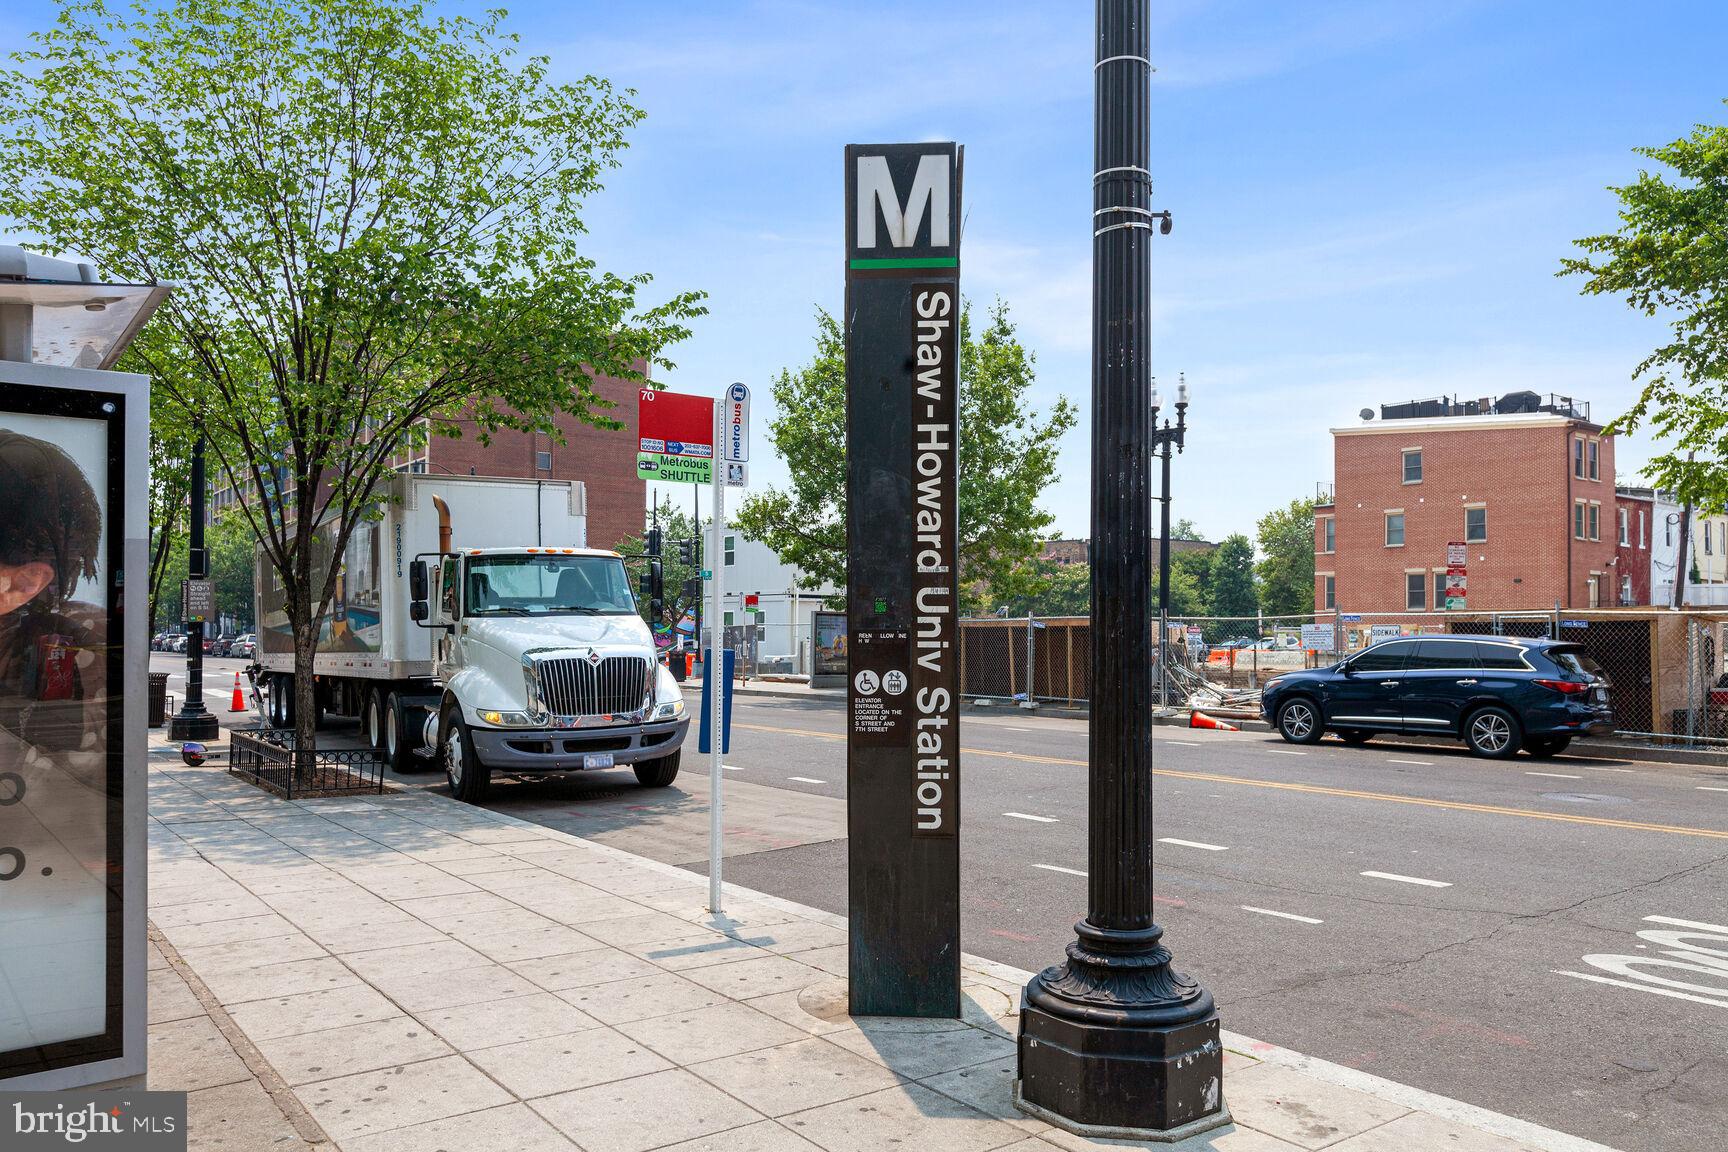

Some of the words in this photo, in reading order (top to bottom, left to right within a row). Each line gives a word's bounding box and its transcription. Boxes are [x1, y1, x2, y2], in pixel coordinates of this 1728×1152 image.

[857, 154, 950, 248] M
[640, 390, 654, 402] 70
[732, 403, 742, 458] metrobus
[916, 290, 950, 572] Shaw-Howard
[660, 456, 709, 470] Metrobus
[660, 470, 710, 483] SHUTTLE
[917, 587, 950, 672] Univ
[916, 687, 950, 830] Station
